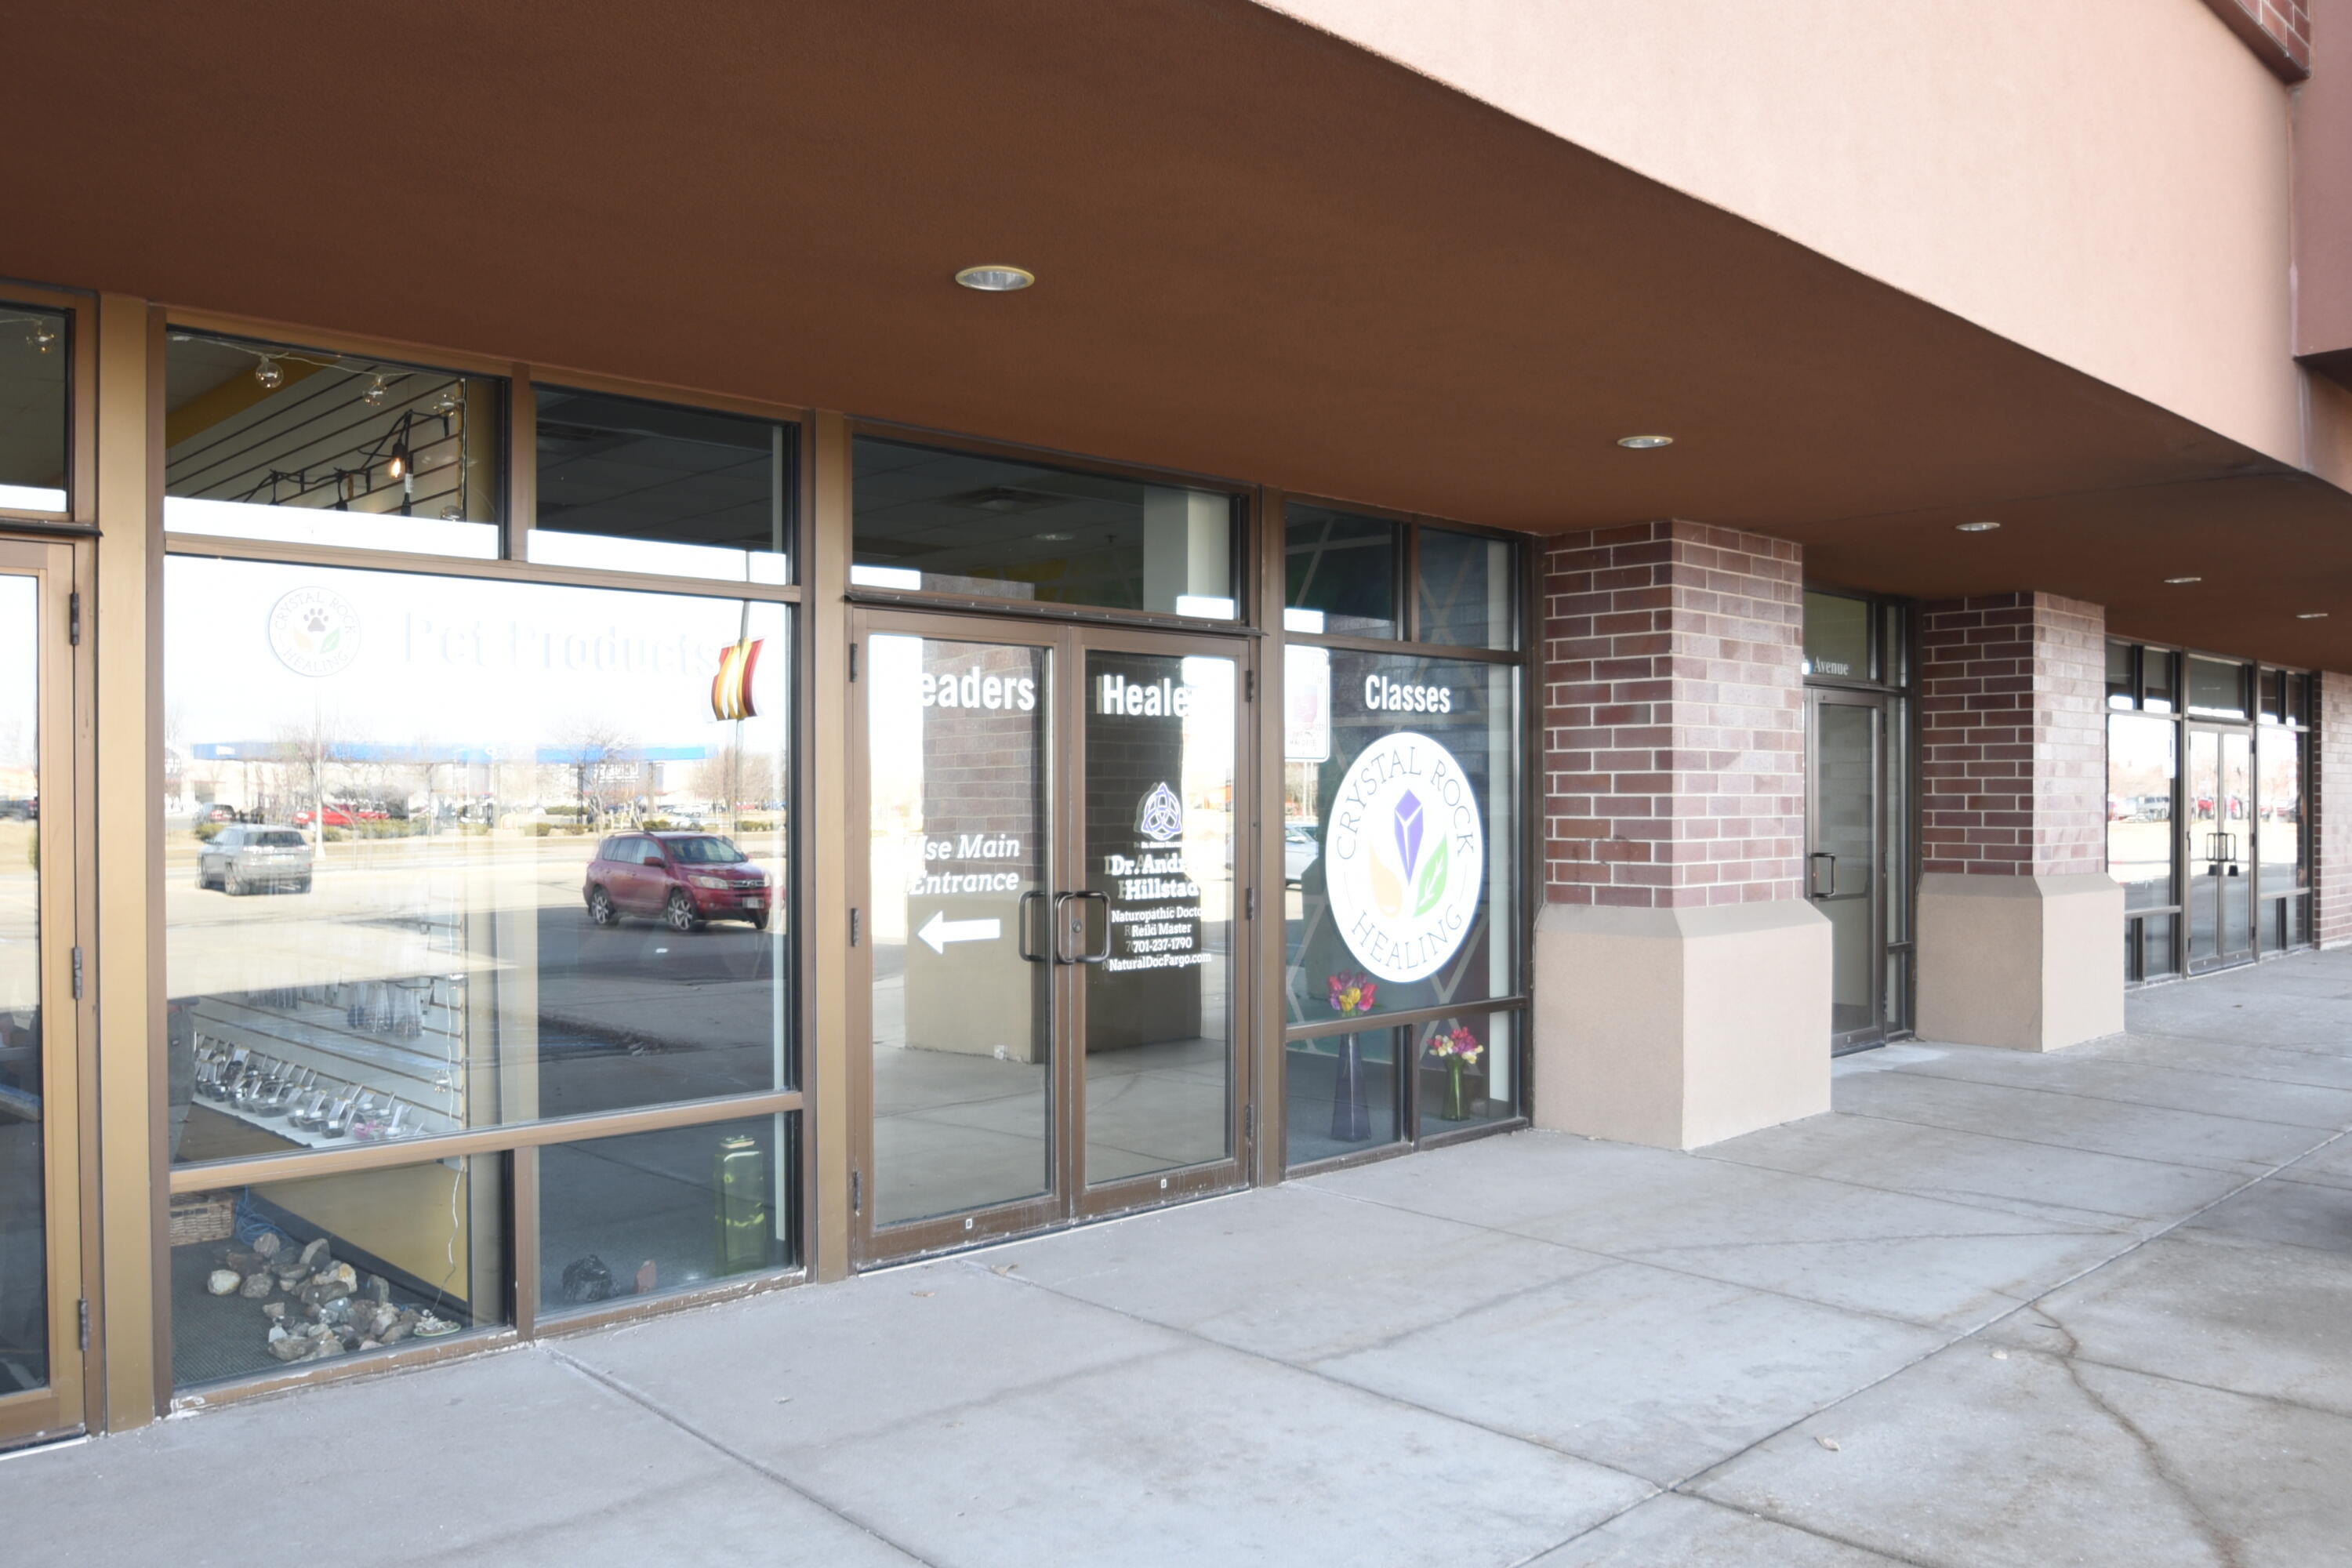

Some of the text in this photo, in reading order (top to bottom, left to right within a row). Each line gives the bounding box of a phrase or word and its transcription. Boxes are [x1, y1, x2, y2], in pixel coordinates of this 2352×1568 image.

[275, 592, 355, 633] CRYSTAL ROCK
[283, 648, 348, 672] HEALING
[1814, 656, 1848, 675] Avenue
[920, 666, 1035, 710] eaders
[1103, 675, 1189, 716] Heale
[1366, 675, 1450, 713] Classes
[1337, 747, 1473, 859] CRYSTAL ROCK
[957, 834, 1019, 858] Main
[1112, 855, 1140, 875] Dr.
[909, 870, 1018, 895] Entrance
[1112, 906, 1202, 923] Naturopathic Docto
[1132, 923, 1192, 937] Reiki Master
[1352, 904, 1461, 970] HEALING
[1134, 938, 1192, 953] 701-237-1790
[1109, 953, 1211, 971] NaturalDocFargo.com
